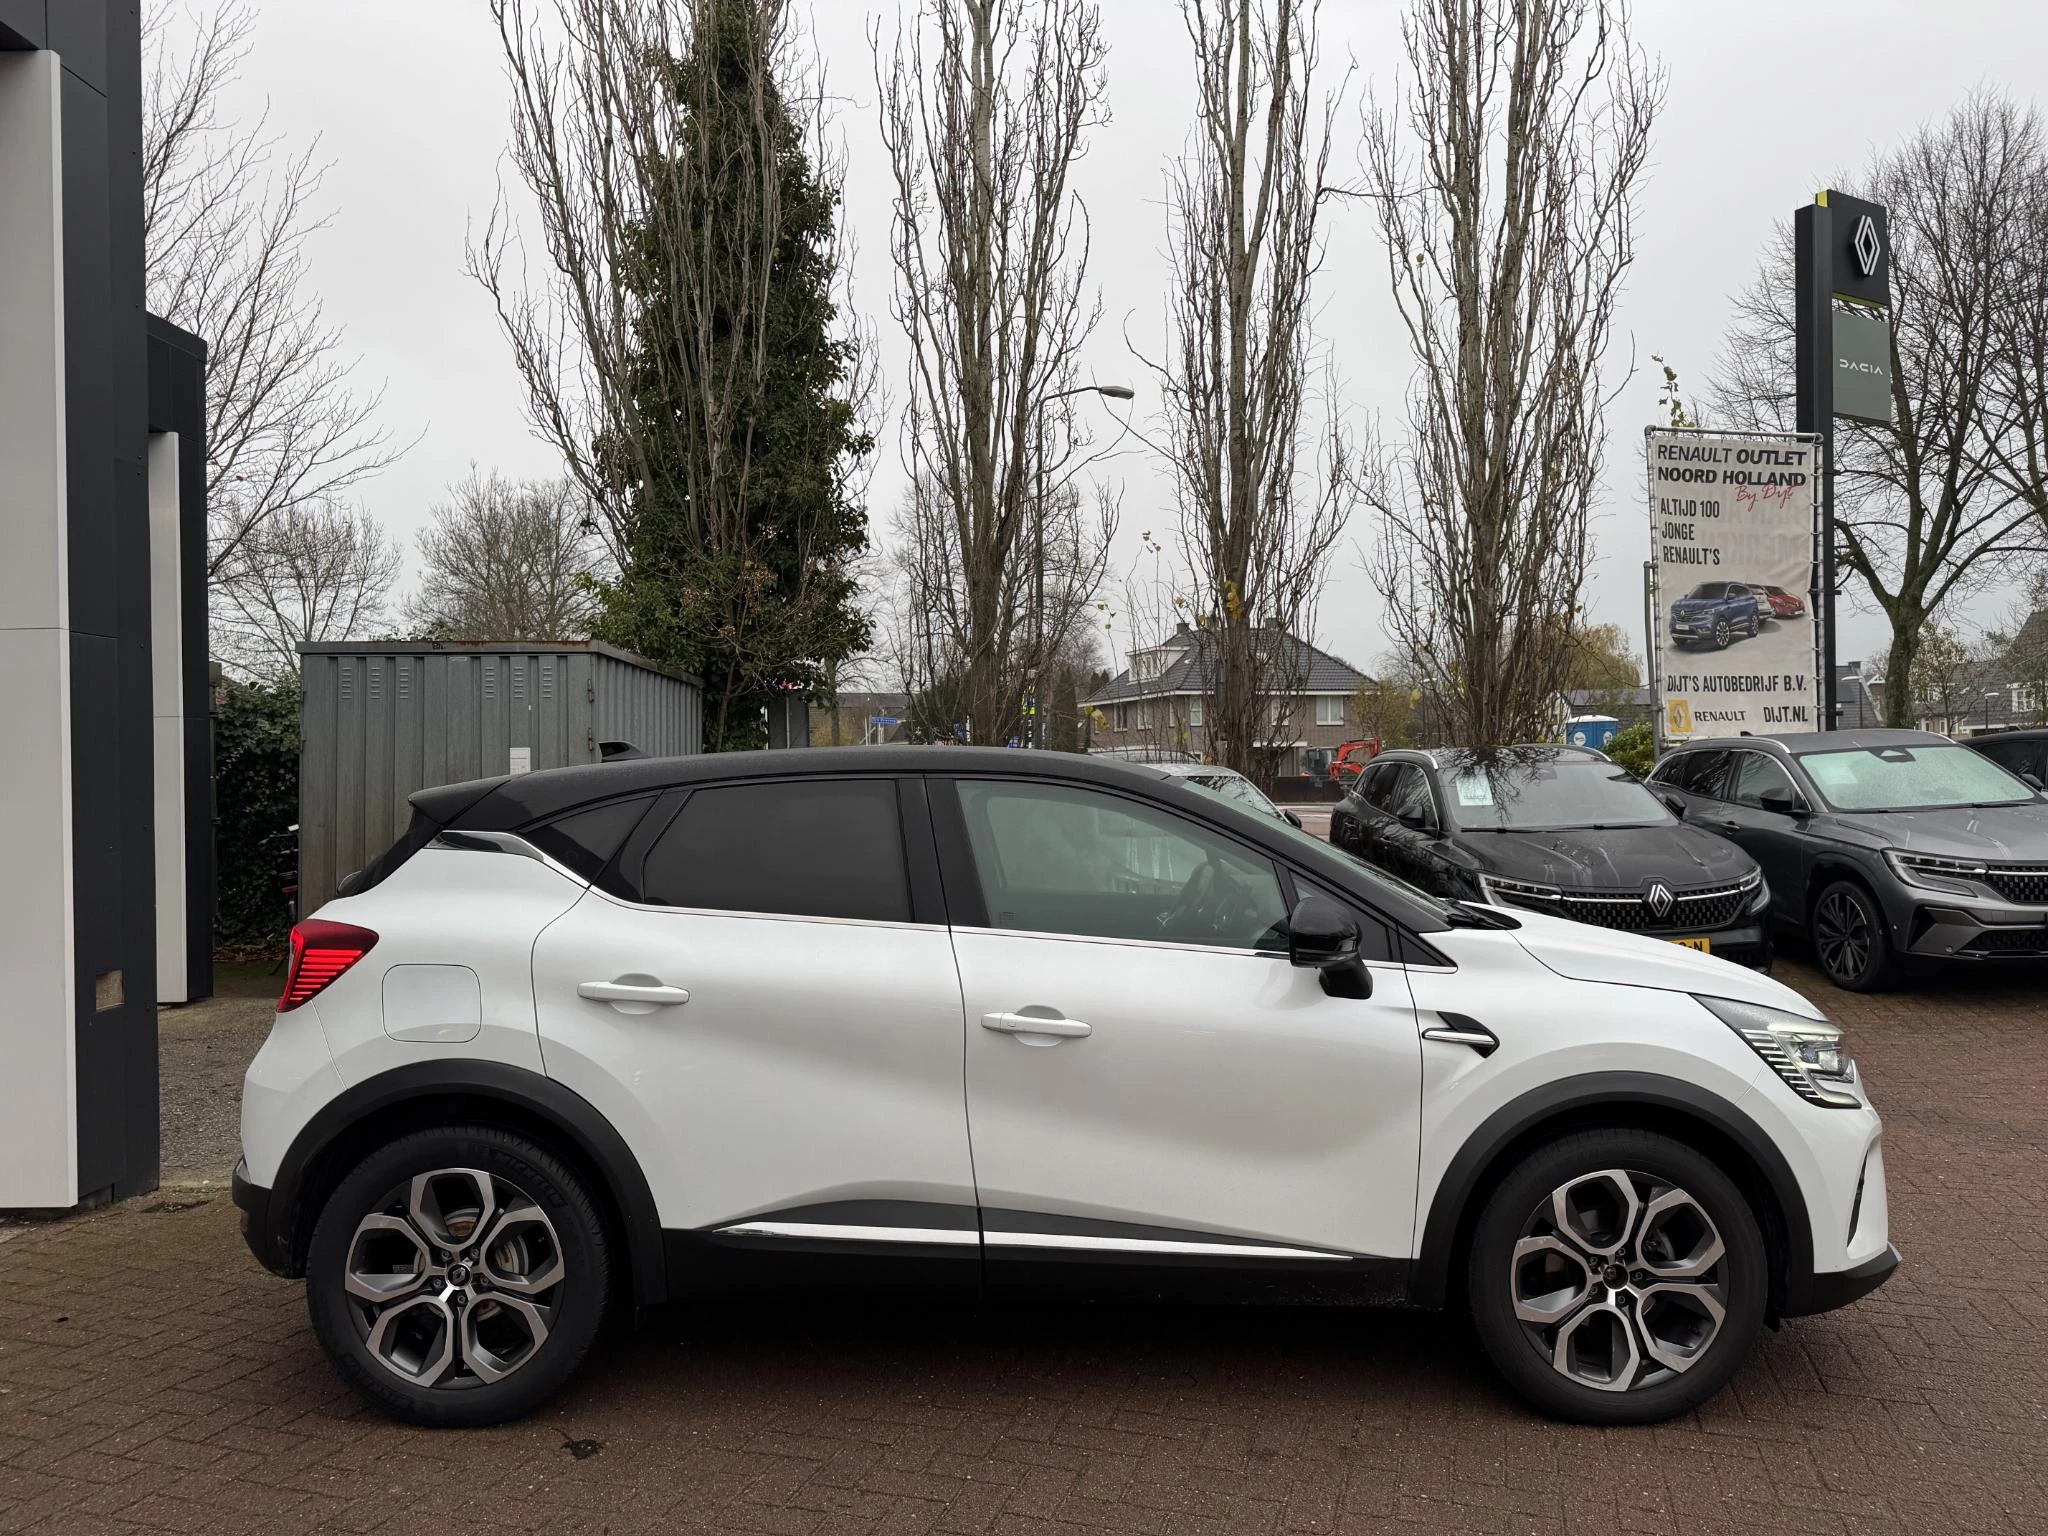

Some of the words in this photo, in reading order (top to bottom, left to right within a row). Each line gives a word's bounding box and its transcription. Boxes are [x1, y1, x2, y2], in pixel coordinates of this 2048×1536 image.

[1839, 358, 1883, 376] DACIA
[1657, 444, 1732, 463] RENAULT
[1736, 449, 1807, 466] OUTLET
[1657, 466, 1717, 484] NOORD
[1722, 470, 1806, 487] HOLLAND
[1660, 497, 1697, 517] ALTIJD
[1700, 500, 1720, 518] 100
[1661, 521, 1695, 541] JONGE
[1663, 545, 1720, 565] RENAULT'S
[1667, 675, 1700, 692] DIJT'S
[1702, 675, 1779, 692] AUTOBEDRIJF
[1783, 675, 1807, 692] B.V.
[1694, 710, 1747, 722] RENAULT
[1763, 706, 1809, 723] DIJT.NL
